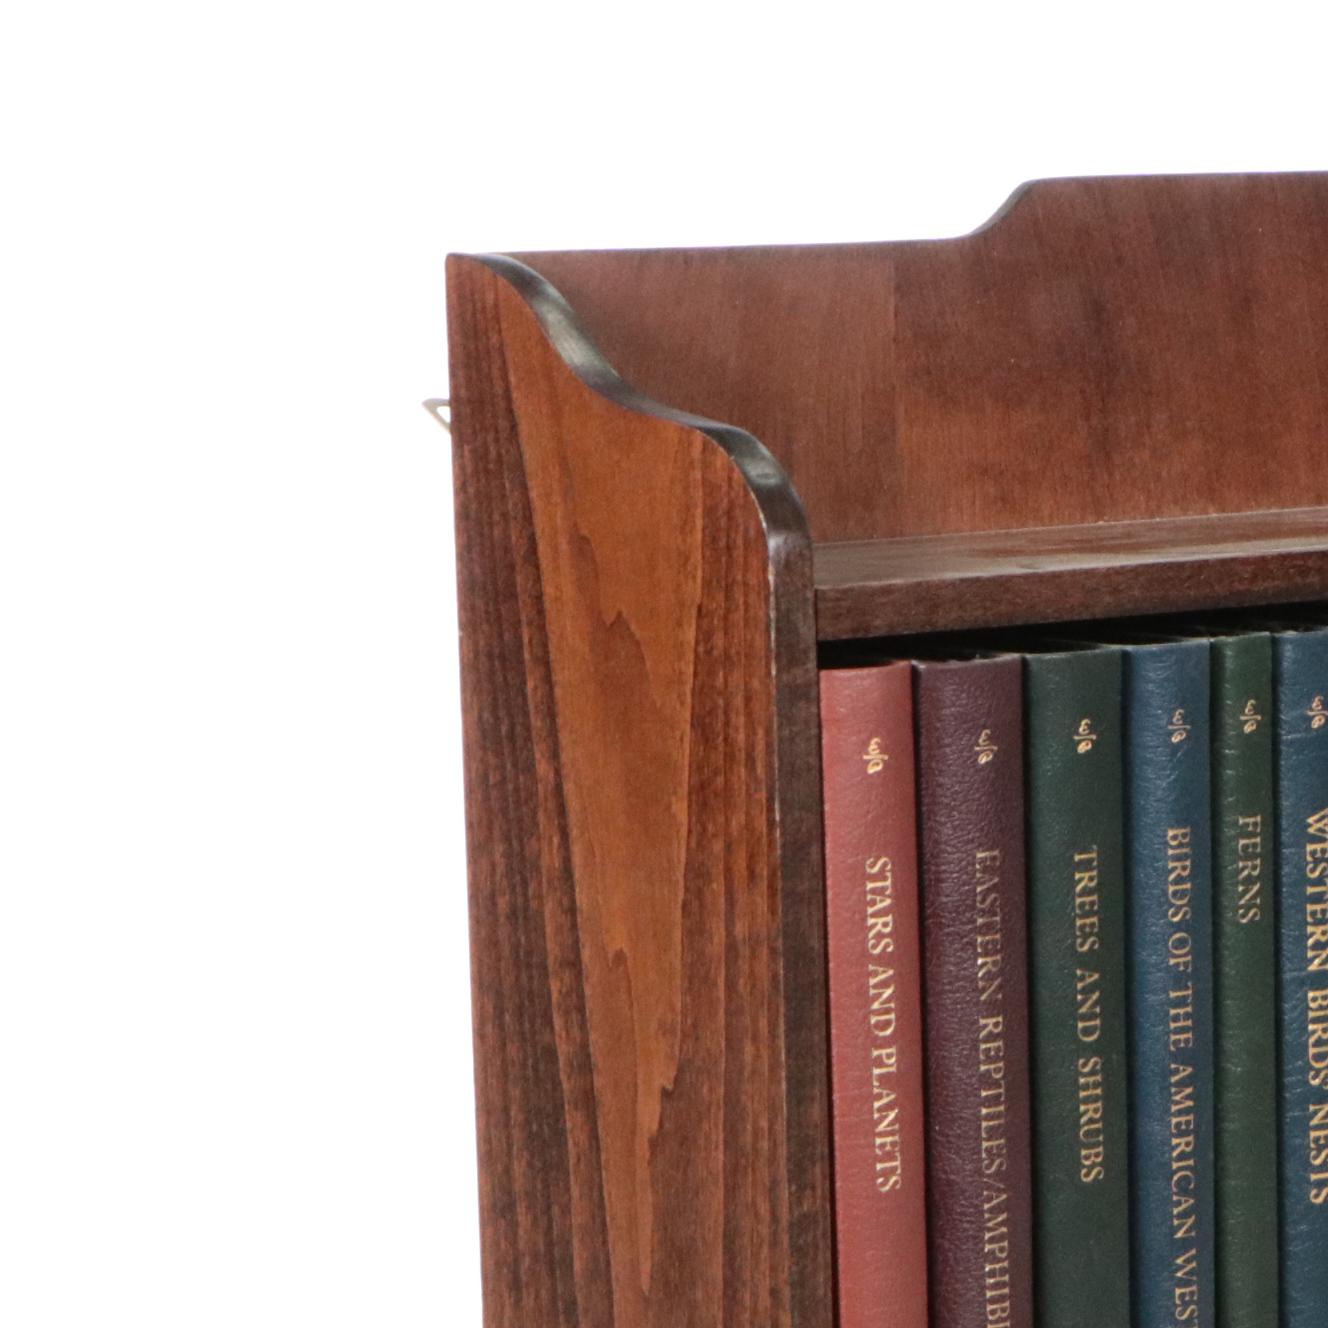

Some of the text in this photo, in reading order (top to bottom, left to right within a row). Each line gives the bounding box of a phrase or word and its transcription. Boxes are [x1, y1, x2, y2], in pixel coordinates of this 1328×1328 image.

[975, 849, 1001, 1004] EASTERN
[1166, 827, 1190, 924] BIRDS
[1238, 815, 1261, 925] FERNS
[1073, 846, 1104, 1184] TREES AND SHRUBS
[1168, 932, 1192, 972] OF
[1169, 980, 1193, 1049] THE
[866, 857, 901, 1193] STARS AND PLANETS
[1171, 1063, 1196, 1238] AMERICAN
